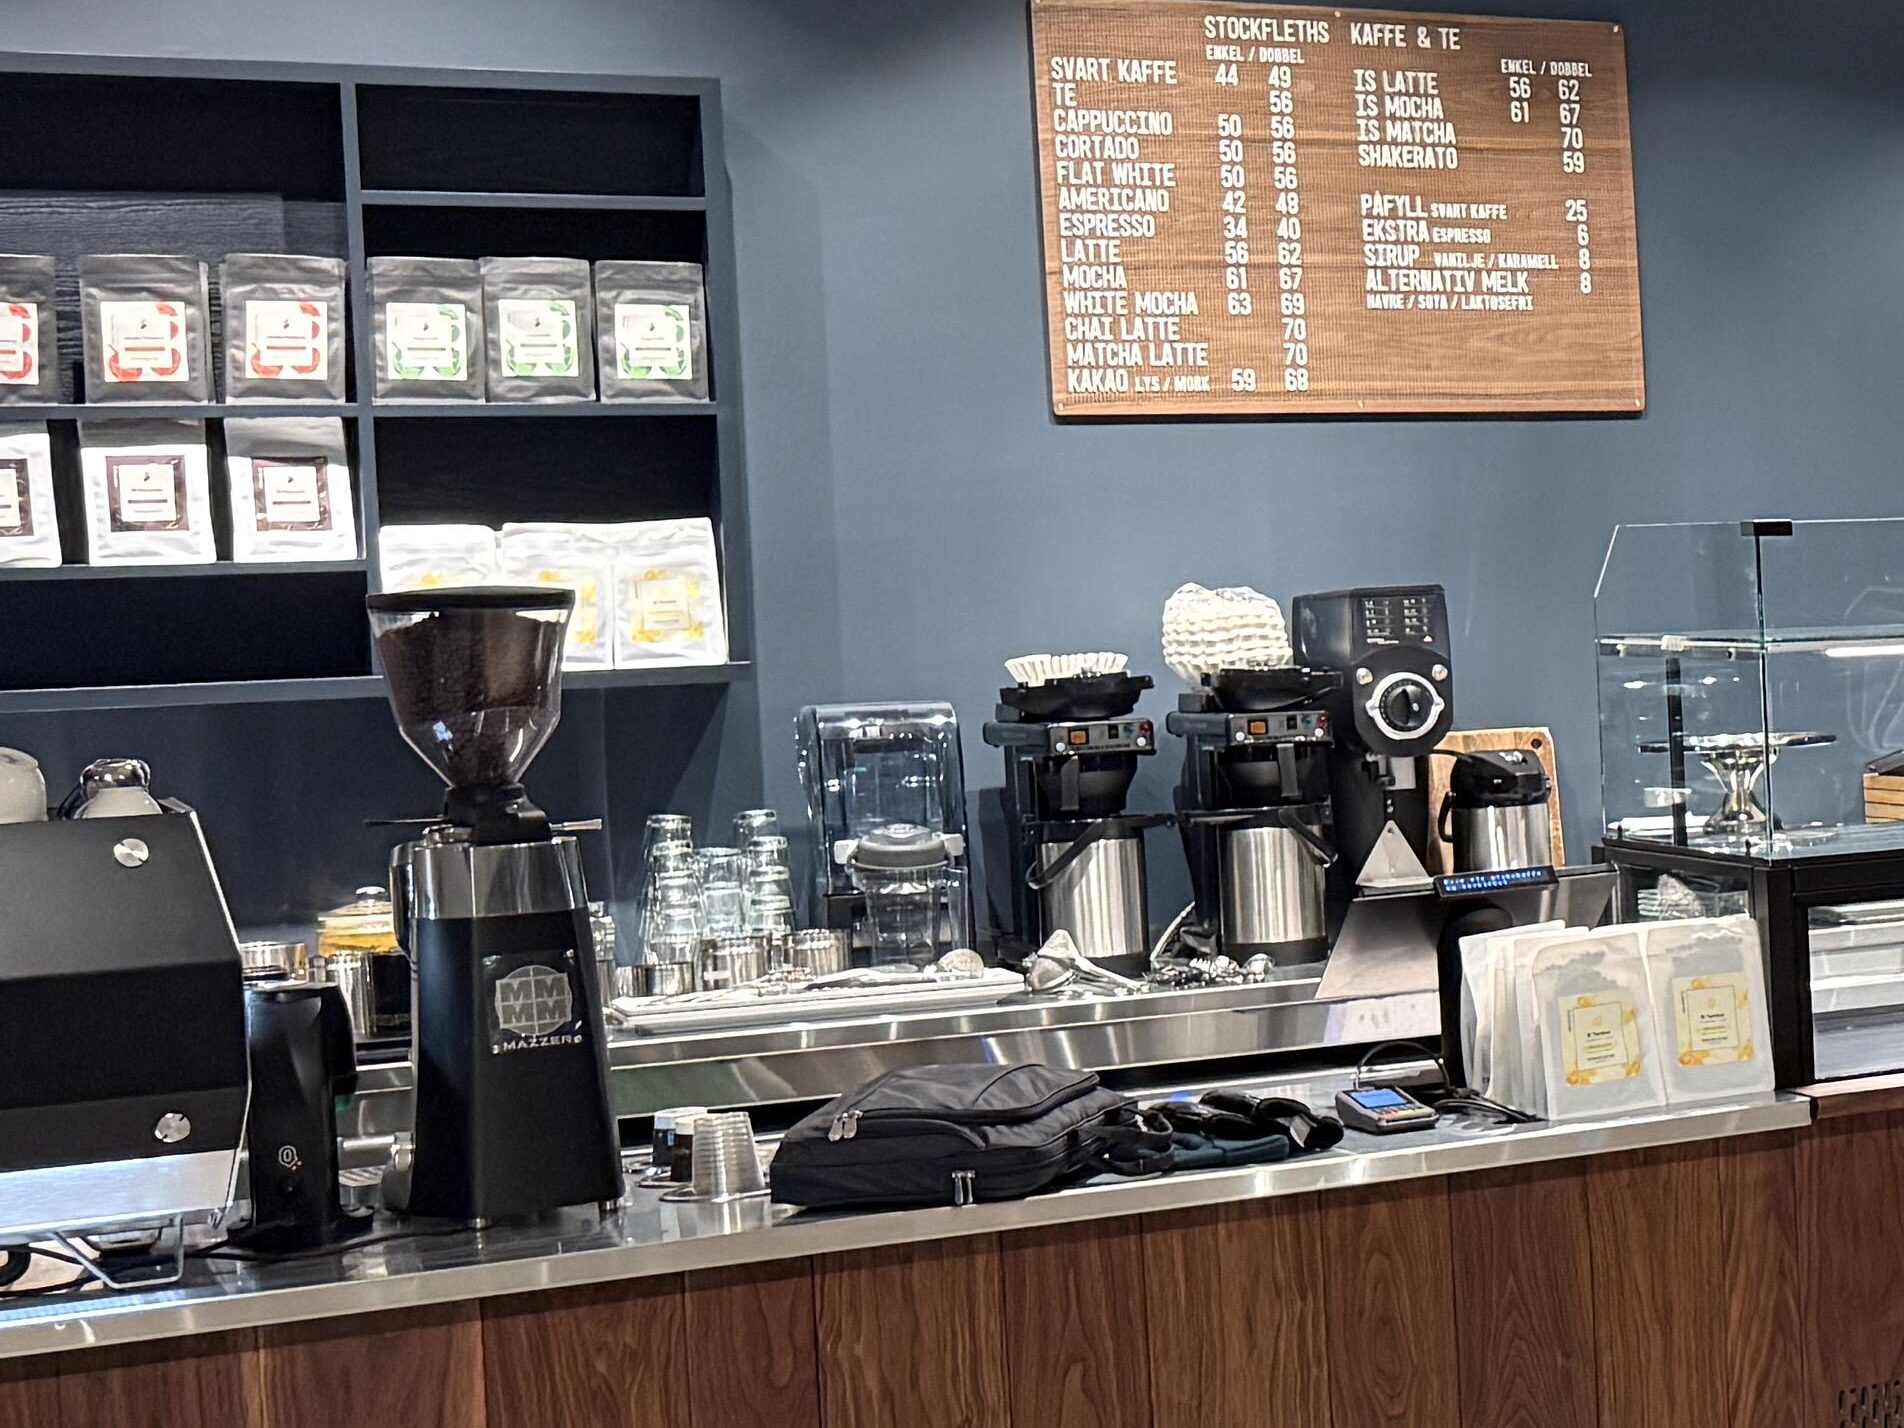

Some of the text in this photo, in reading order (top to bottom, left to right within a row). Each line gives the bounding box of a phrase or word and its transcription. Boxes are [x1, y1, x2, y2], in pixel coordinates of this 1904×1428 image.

[1204, 15, 1461, 50] STOCKFLETHS KAFFE & TE
[1206, 45, 1304, 63] ENKEL / DOBBEL
[1051, 57, 1291, 88] SVART KAFFE 44 49
[1501, 58, 1592, 77] ENKEL / DOBBEL
[1354, 68, 1580, 101] IS LATTE 56 62
[1053, 83, 1293, 113] TE 56
[1355, 94, 1580, 125] IS MOCHA 61 67
[1054, 109, 1294, 139] CAPPUCCINO 50 56
[1357, 119, 1583, 149] IS MATCHA 70
[1055, 135, 1295, 164] CORTADO 50 56
[1358, 145, 1584, 173] SHAKERATO 59
[1057, 161, 1297, 189] FLAT WHITE 50 56
[1059, 187, 1299, 215] AMERICANO 42 48
[1361, 191, 1587, 221] PÅFYLL SVART KAFFE 25
[1060, 214, 1300, 240] ESPRESSO 34 40
[1363, 220, 1588, 245] EKSTRA ESPRESSO 6
[1061, 240, 1302, 264] LATTE 56 62
[1364, 245, 1590, 269] SIRUP VANILJE / KARAMELL 8
[1062, 266, 1302, 290] MOCHA 61 67
[1366, 269, 1591, 294] ALTERNATIV MELK 8
[1064, 291, 1304, 315] WHITE MOCHA 63 69
[1407, 295, 1414, 310] /
[1451, 296, 1458, 310] /
[1461, 295, 1534, 311] LAKTOSEFRI
[1064, 317, 1306, 341] CHAI LATTE 70
[1067, 343, 1308, 367] MATCHA LATTE 70
[1068, 369, 1128, 392] KAKAO
[1163, 376, 1171, 391] /
[1232, 368, 1256, 391] 59
[1284, 368, 1309, 392] 68
[503, 1035, 573, 1051] MAZZER
